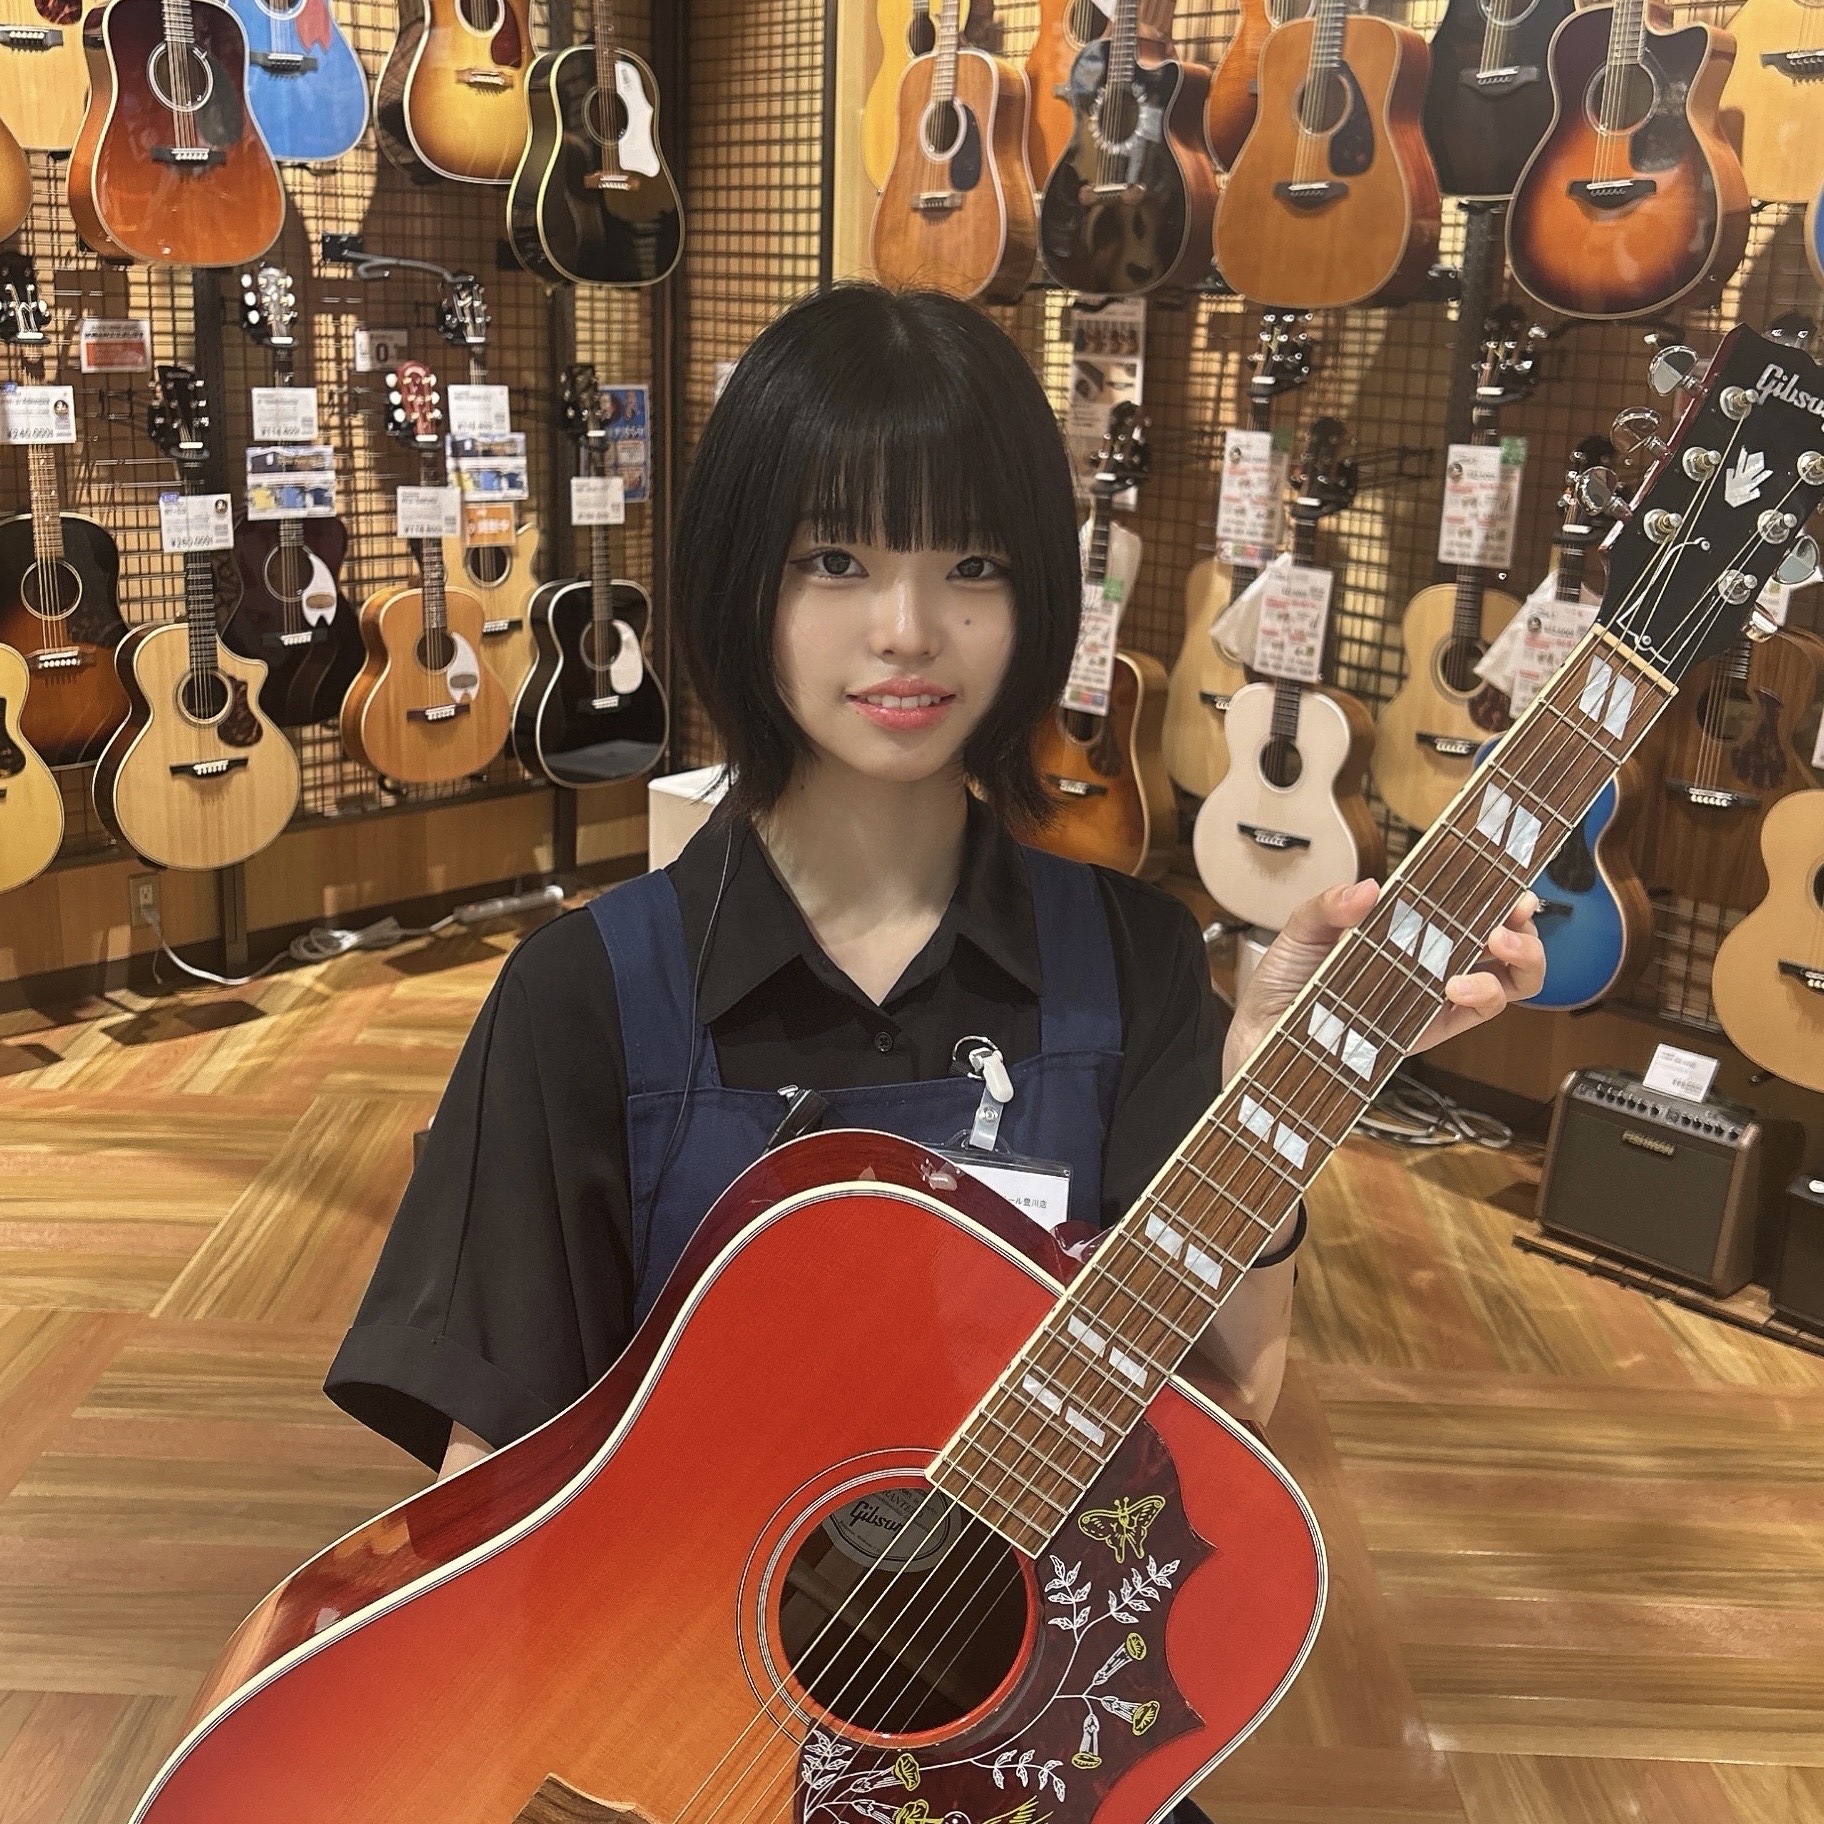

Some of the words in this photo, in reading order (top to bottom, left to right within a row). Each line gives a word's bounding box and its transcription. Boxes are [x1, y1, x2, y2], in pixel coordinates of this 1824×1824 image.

[1755, 363, 1824, 419] Gibso
[1005, 1196, 1047, 1209] ール豊川店
